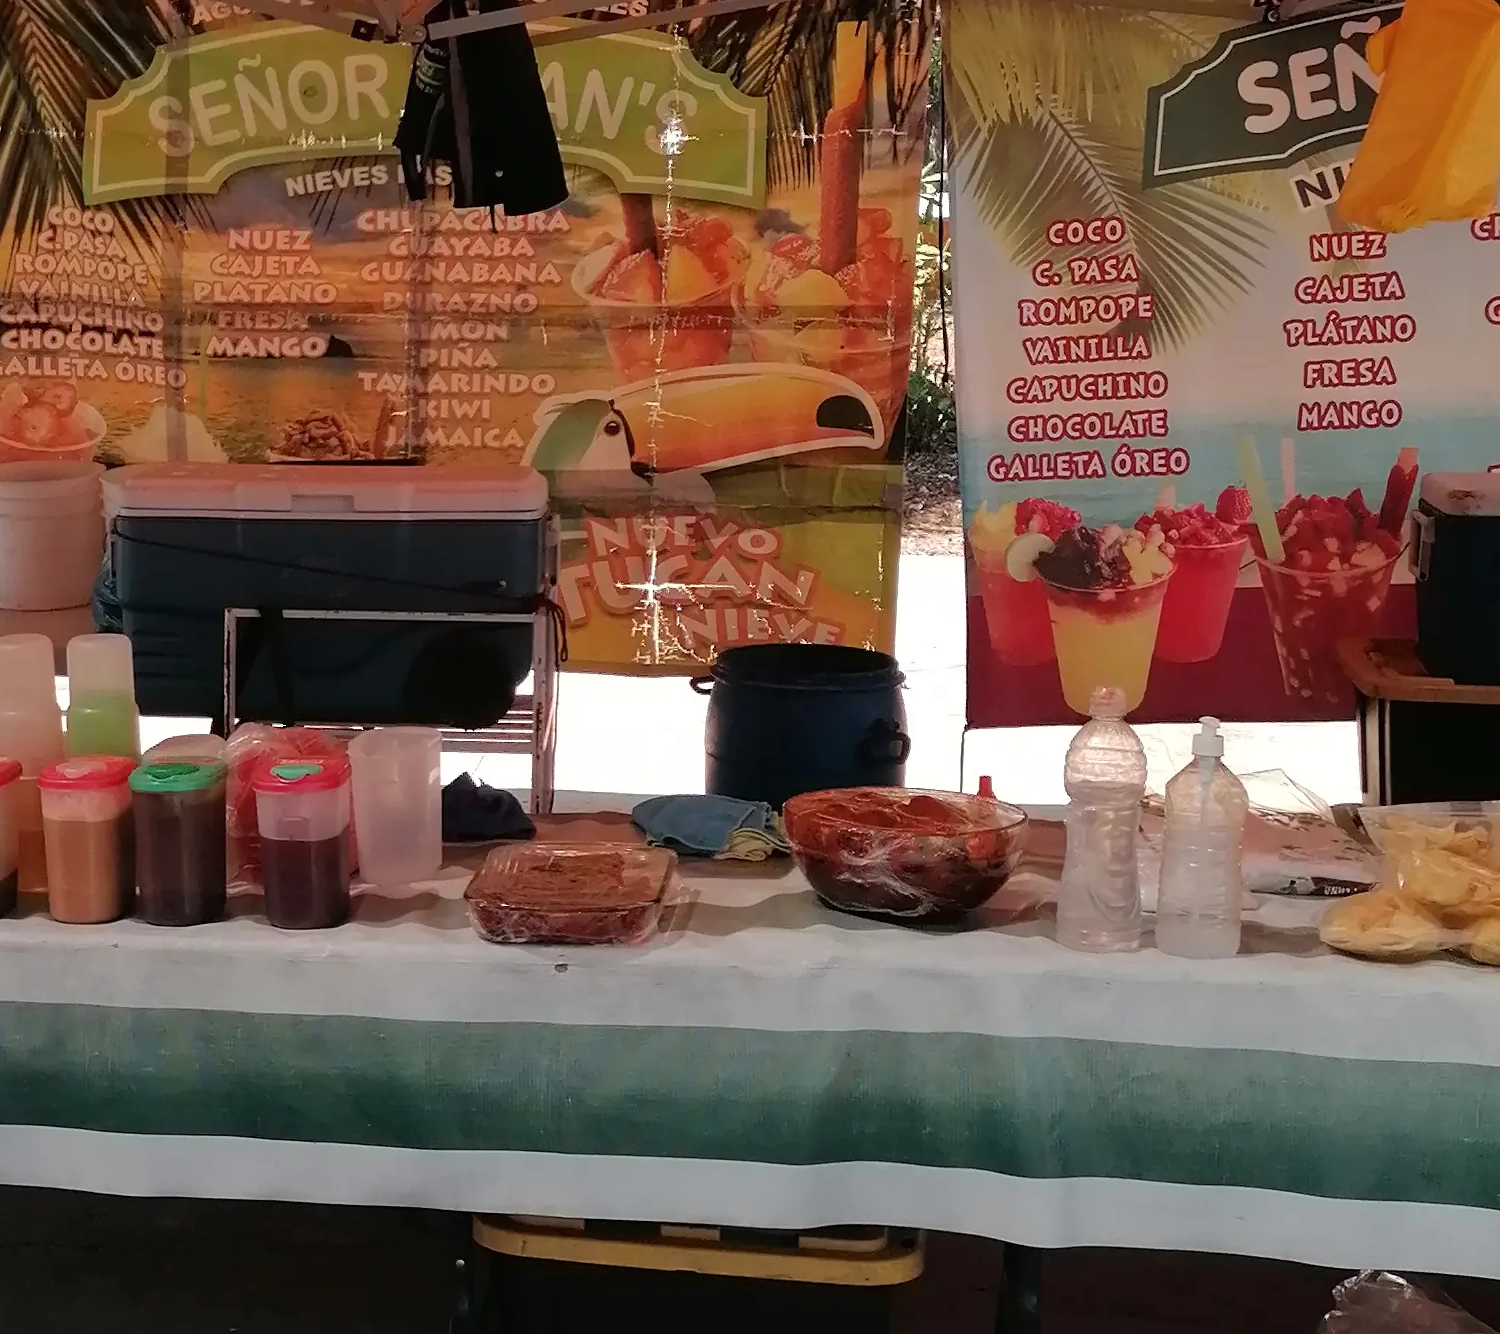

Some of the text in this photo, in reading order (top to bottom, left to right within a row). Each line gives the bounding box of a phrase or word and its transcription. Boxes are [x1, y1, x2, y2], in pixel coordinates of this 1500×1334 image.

[148, 53, 391, 157] SEÑOR
[284, 164, 389, 198] NIEVES
[48, 206, 115, 233] COCO
[1048, 216, 1126, 247] COCO
[228, 228, 312, 252] NUEZ
[388, 235, 536, 258] GUAYABA
[1310, 231, 1387, 261] NUEZ
[15, 252, 150, 286] ROMPOPE
[210, 254, 322, 279] CAJETA
[360, 261, 563, 284] GUANABANA
[1032, 254, 1140, 287] C. PASA
[18, 278, 147, 308] VAINILLA
[1294, 270, 1406, 304] CAJETA
[217, 310, 309, 331] FRESA
[1018, 294, 1155, 326] ROMPOPE
[0, 328, 164, 360] CHOCOLATE
[1283, 309, 1417, 347] PLÁTANO
[206, 335, 328, 359] MANGO
[420, 342, 499, 368] PIÑA
[1023, 334, 1152, 366] VAINILLA
[1006, 370, 1169, 403] CAPUCHINO
[1303, 356, 1397, 388] FRESA
[418, 398, 492, 419] KIWI
[1296, 399, 1403, 431] MANGO
[1007, 409, 1170, 443] CHOCOLATE
[987, 443, 1190, 482] GALLETA ÓREO
[589, 515, 779, 557] NUEVO
[559, 554, 819, 622] TUCAN
